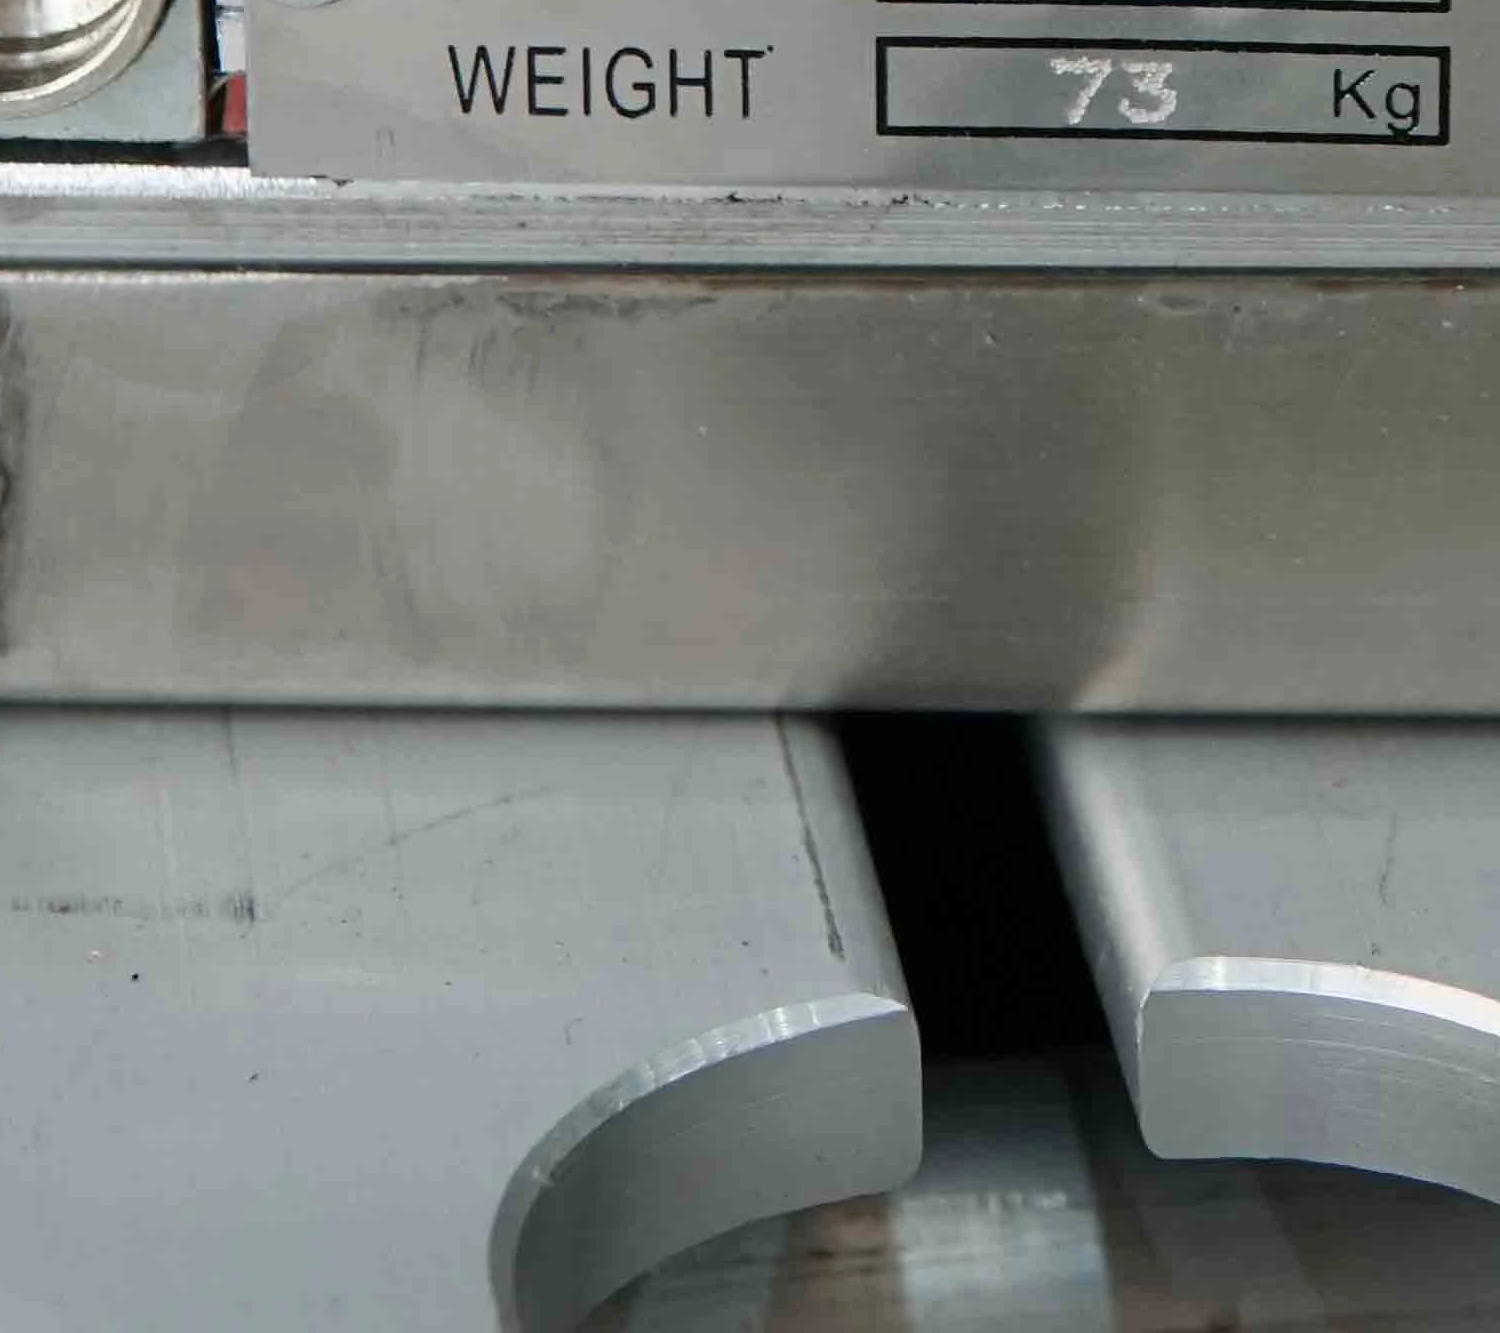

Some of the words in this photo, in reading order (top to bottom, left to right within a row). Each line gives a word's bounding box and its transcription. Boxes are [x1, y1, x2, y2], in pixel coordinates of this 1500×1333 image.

[449, 45, 765, 118] WEIGHT
[1050, 55, 1178, 127] 73
[1331, 67, 1422, 134] Kg
